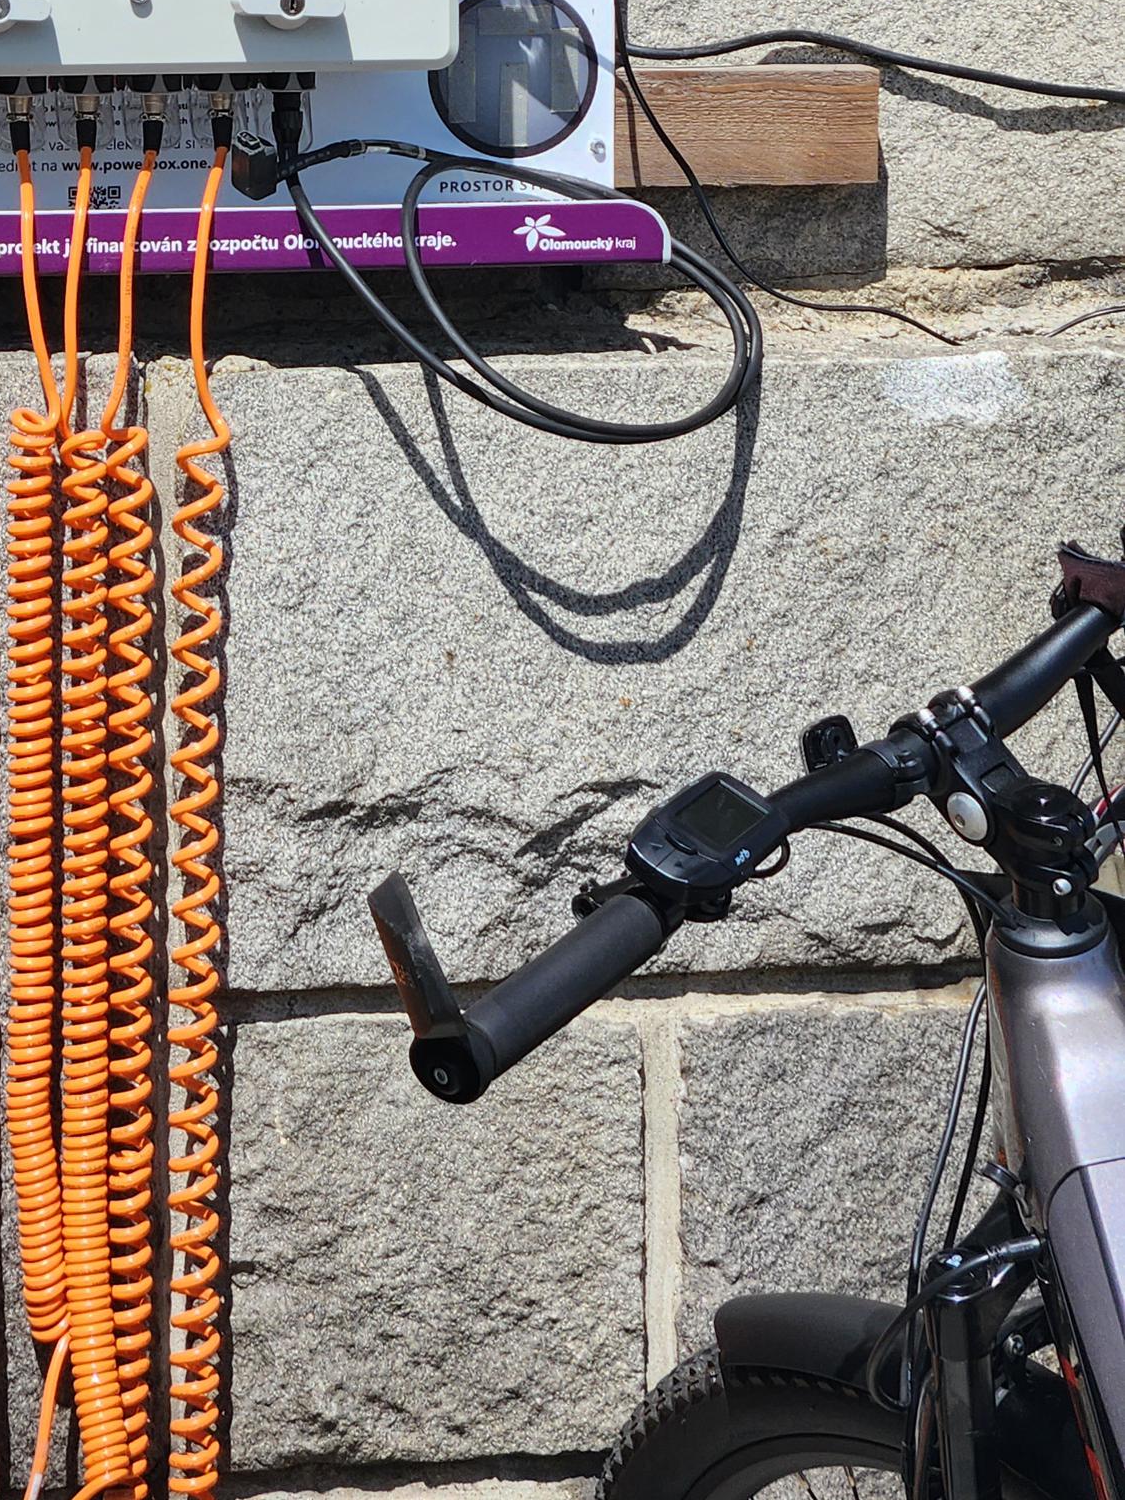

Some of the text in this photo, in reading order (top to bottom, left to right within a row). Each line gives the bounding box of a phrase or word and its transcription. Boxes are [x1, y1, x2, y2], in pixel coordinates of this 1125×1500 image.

[41, 162, 58, 172] na
[62, 159, 212, 175] www.powebox.one.
[439, 180, 515, 193] PROSTOR
[187, 240, 197, 252] z
[209, 235, 279, 255] ozpočtu
[284, 232, 404, 251] Oloouckého
[539, 235, 637, 253] Olomoucký kraj
